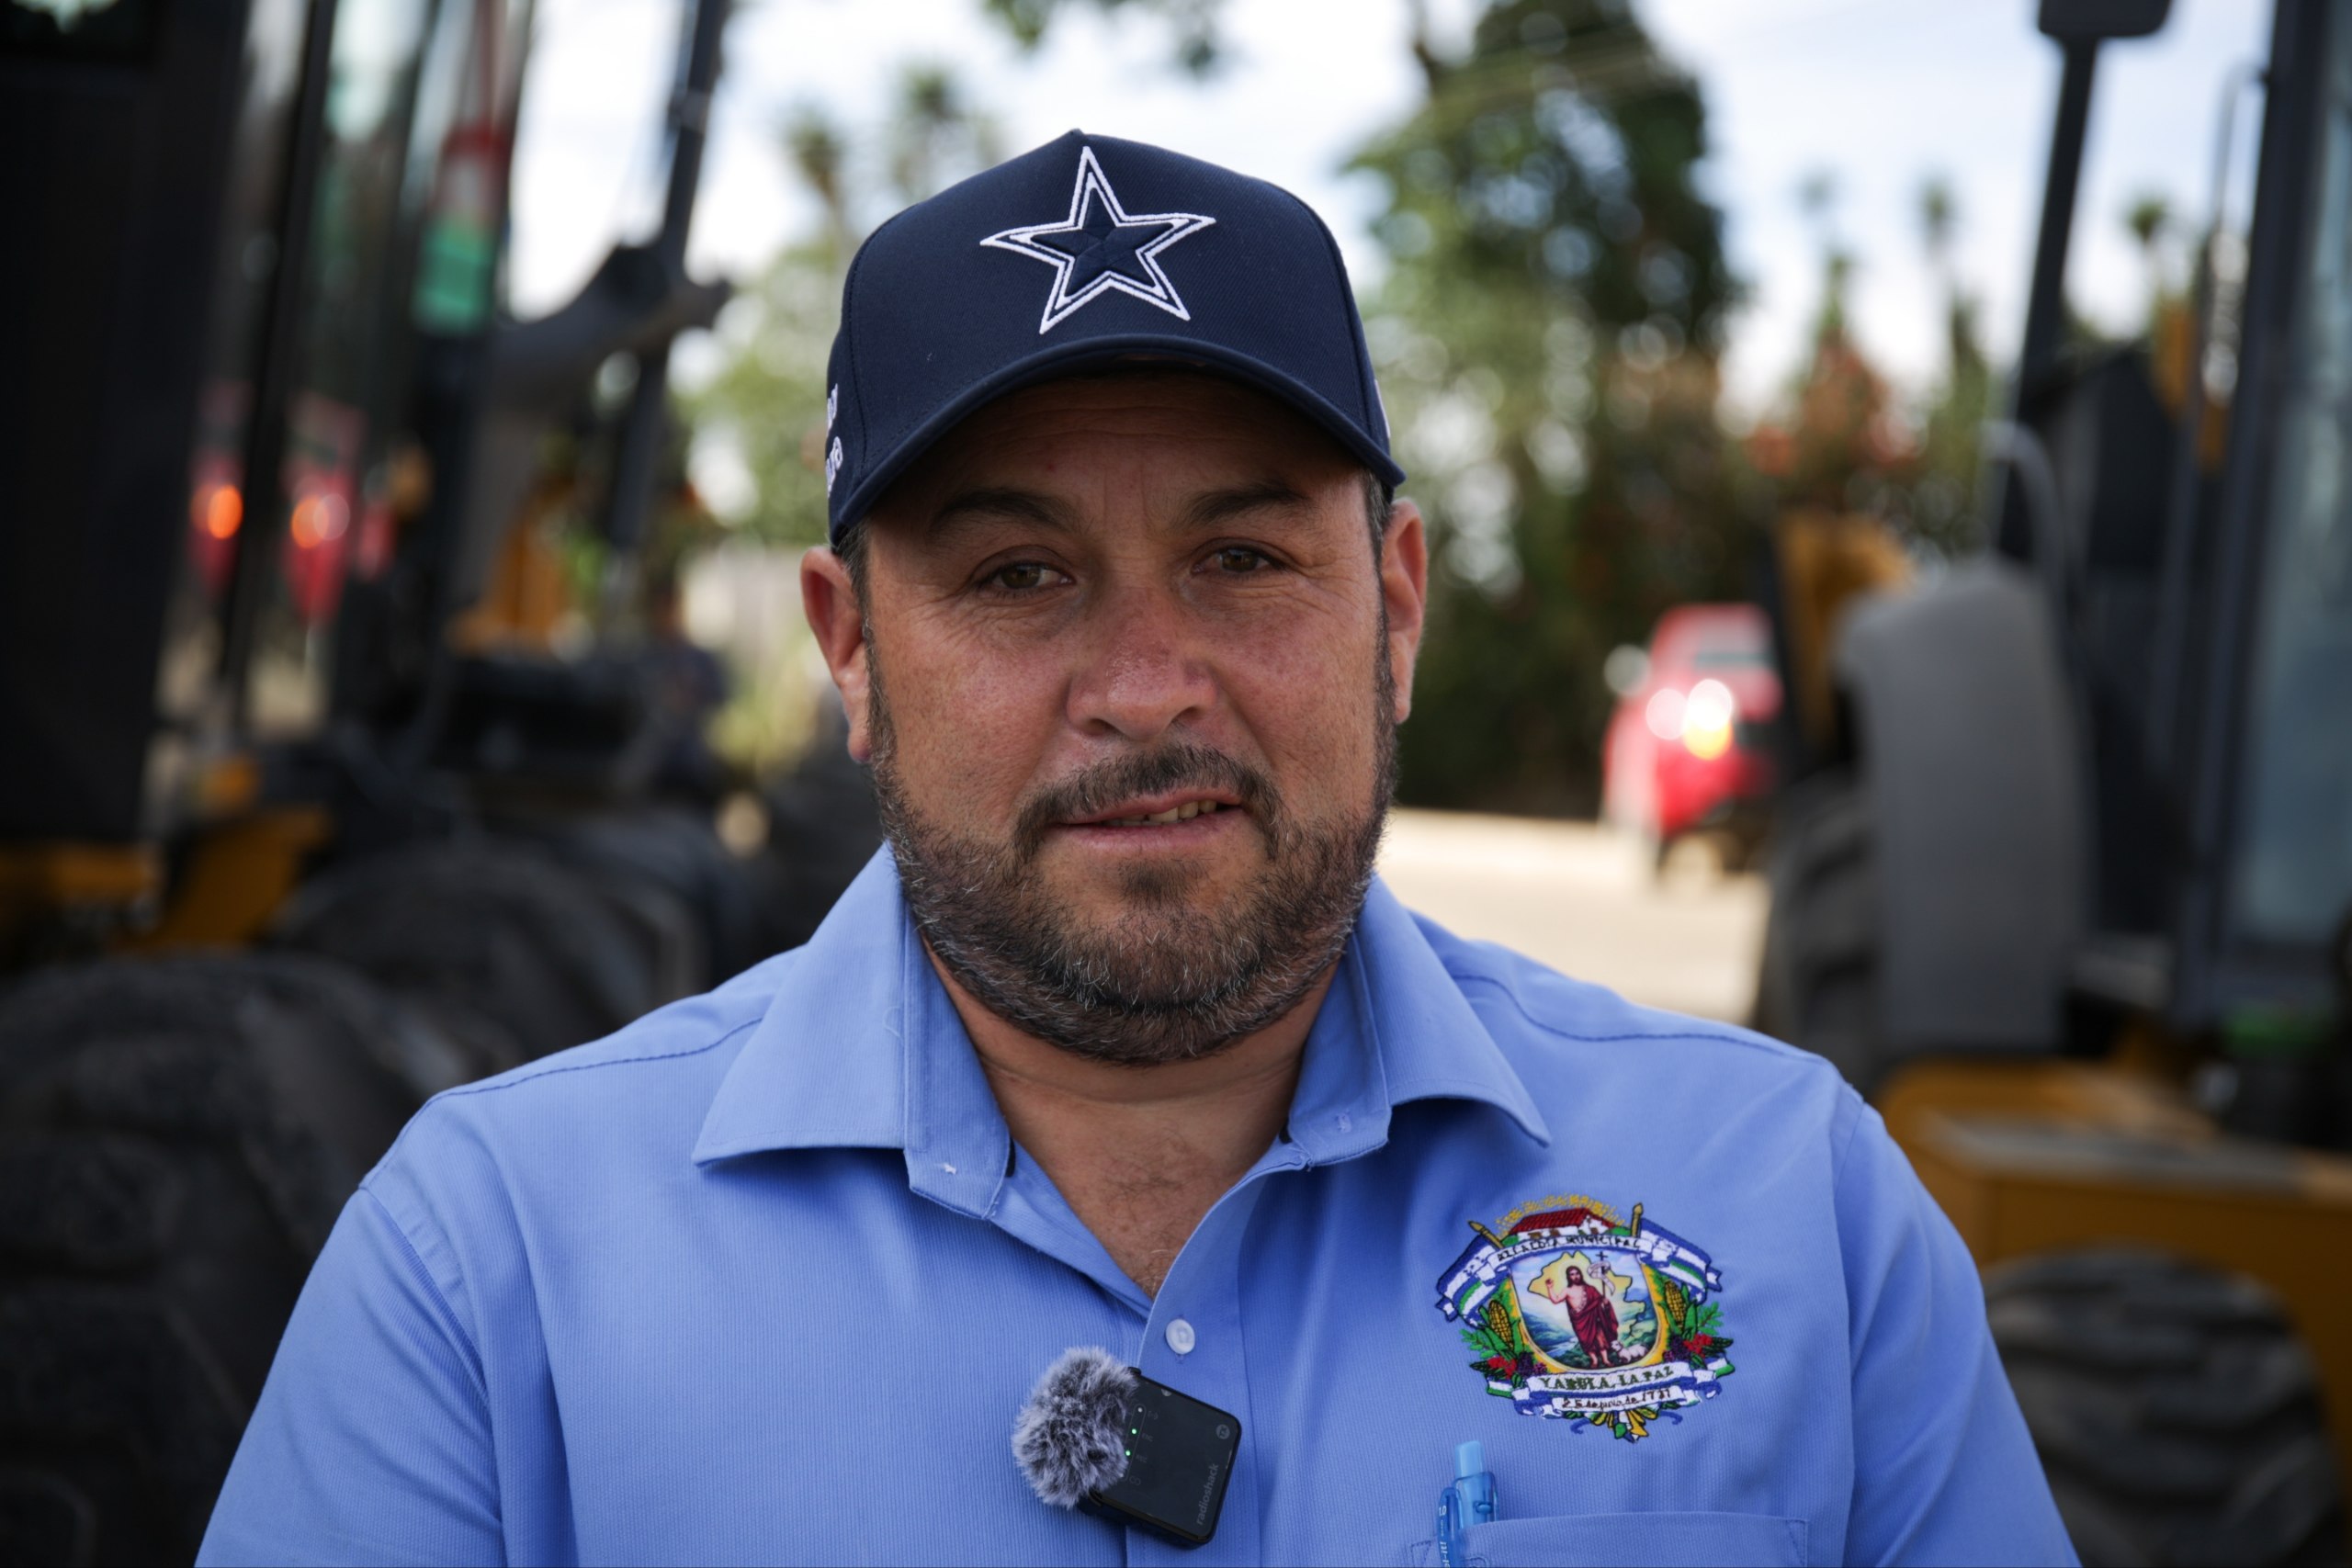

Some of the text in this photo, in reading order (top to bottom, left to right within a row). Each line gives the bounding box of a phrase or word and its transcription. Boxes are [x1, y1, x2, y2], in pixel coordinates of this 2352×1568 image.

[1566, 1235, 1641, 1248] MUNICIPAL
[1618, 1373, 1642, 1386] LA
[1643, 1366, 1674, 1382] PAZ
[1196, 1463, 1218, 1525] radioshack
